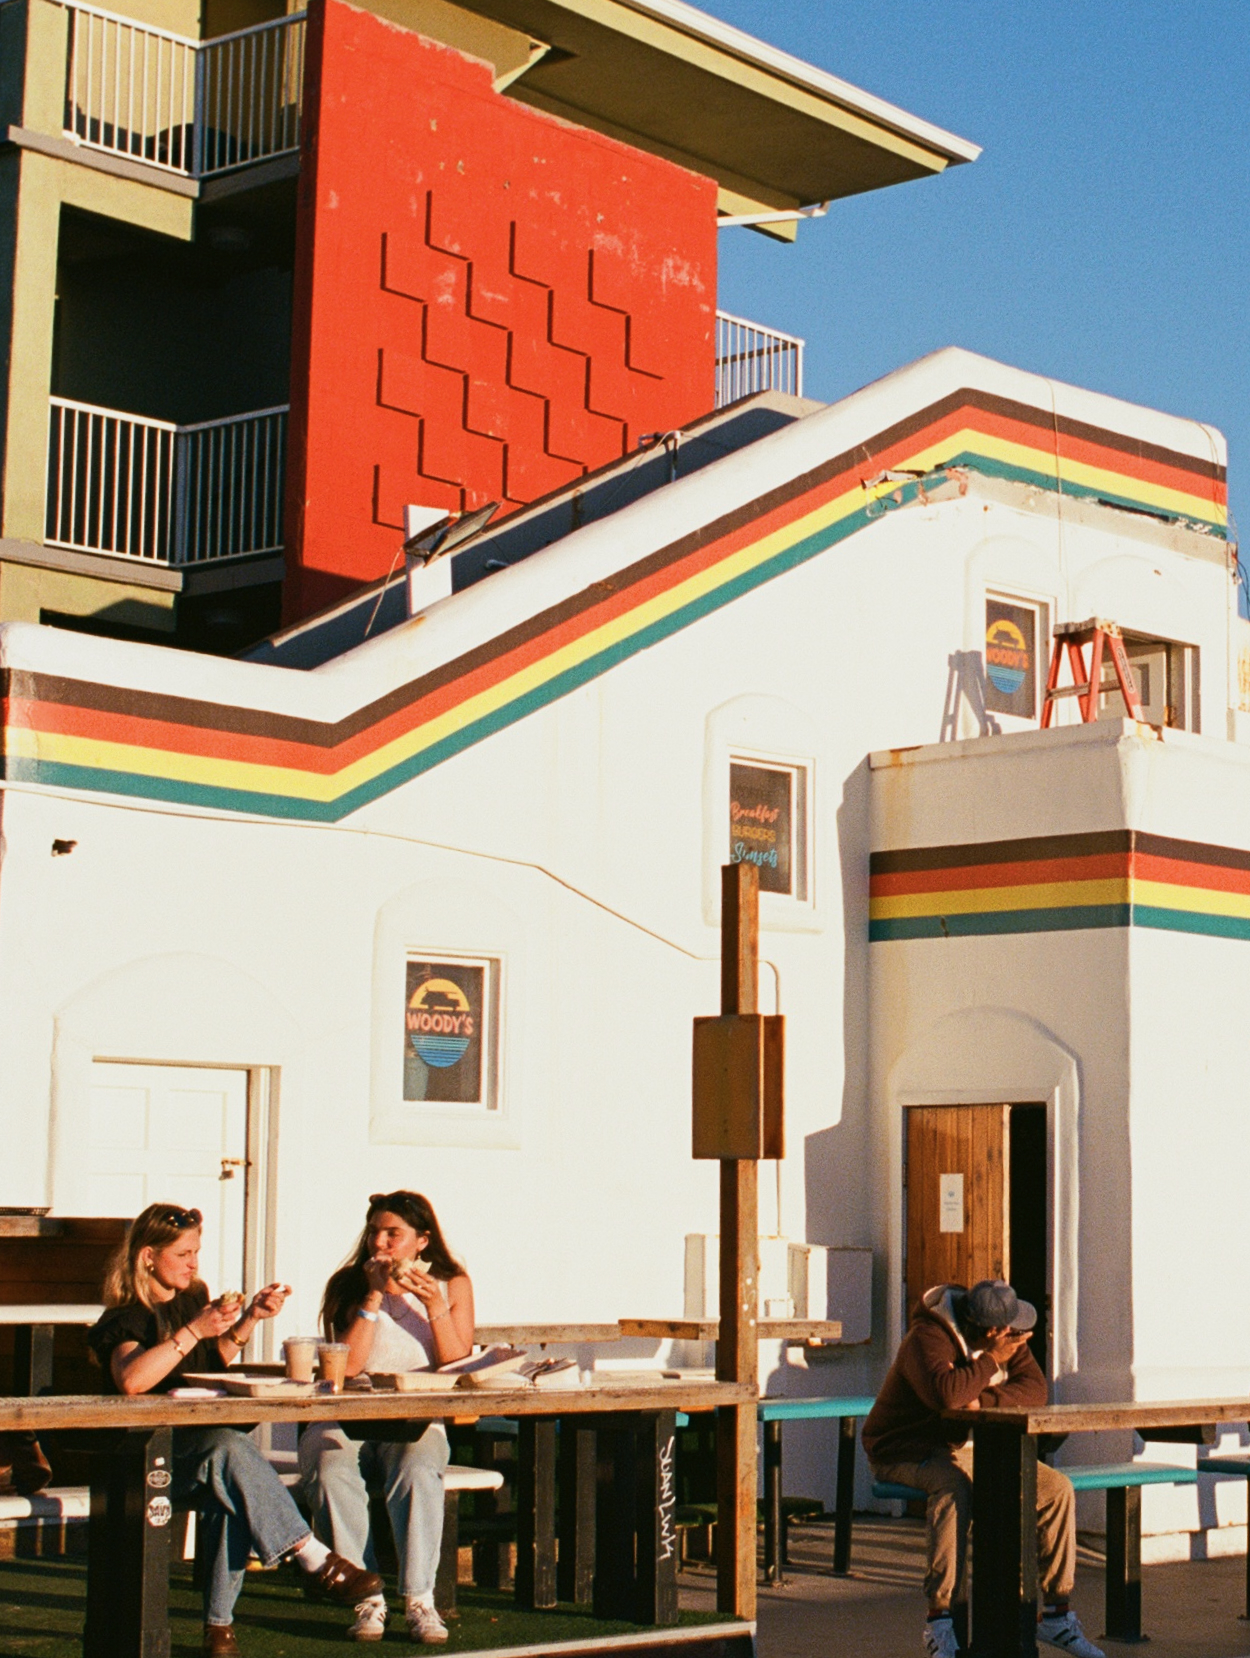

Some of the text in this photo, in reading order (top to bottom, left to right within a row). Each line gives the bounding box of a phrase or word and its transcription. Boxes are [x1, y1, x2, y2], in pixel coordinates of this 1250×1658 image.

[730, 801, 779, 823] Breakfast
[732, 824, 776, 842] BURGERS
[730, 842, 777, 868] Sunsets
[406, 1012, 474, 1035] WOODY'S
